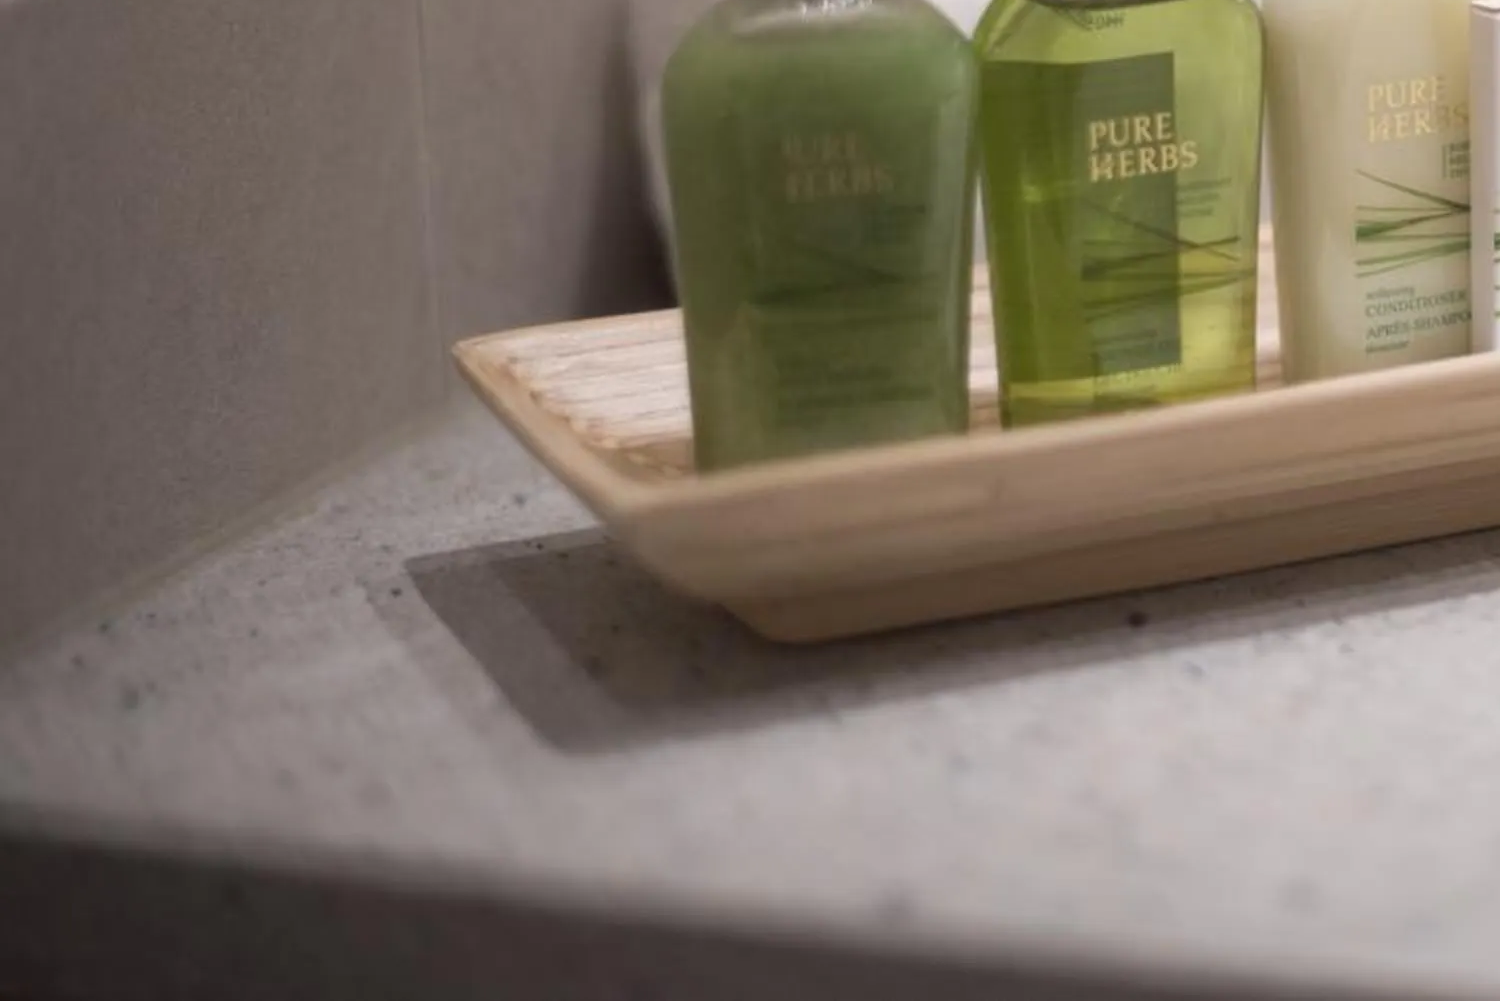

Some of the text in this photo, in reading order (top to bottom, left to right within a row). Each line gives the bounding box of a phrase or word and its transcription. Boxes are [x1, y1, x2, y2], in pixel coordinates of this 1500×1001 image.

[1368, 75, 1445, 112] PURE
[1089, 112, 1172, 151] PURE
[1367, 103, 1470, 143] HERBS
[1089, 140, 1198, 182] HERBS
